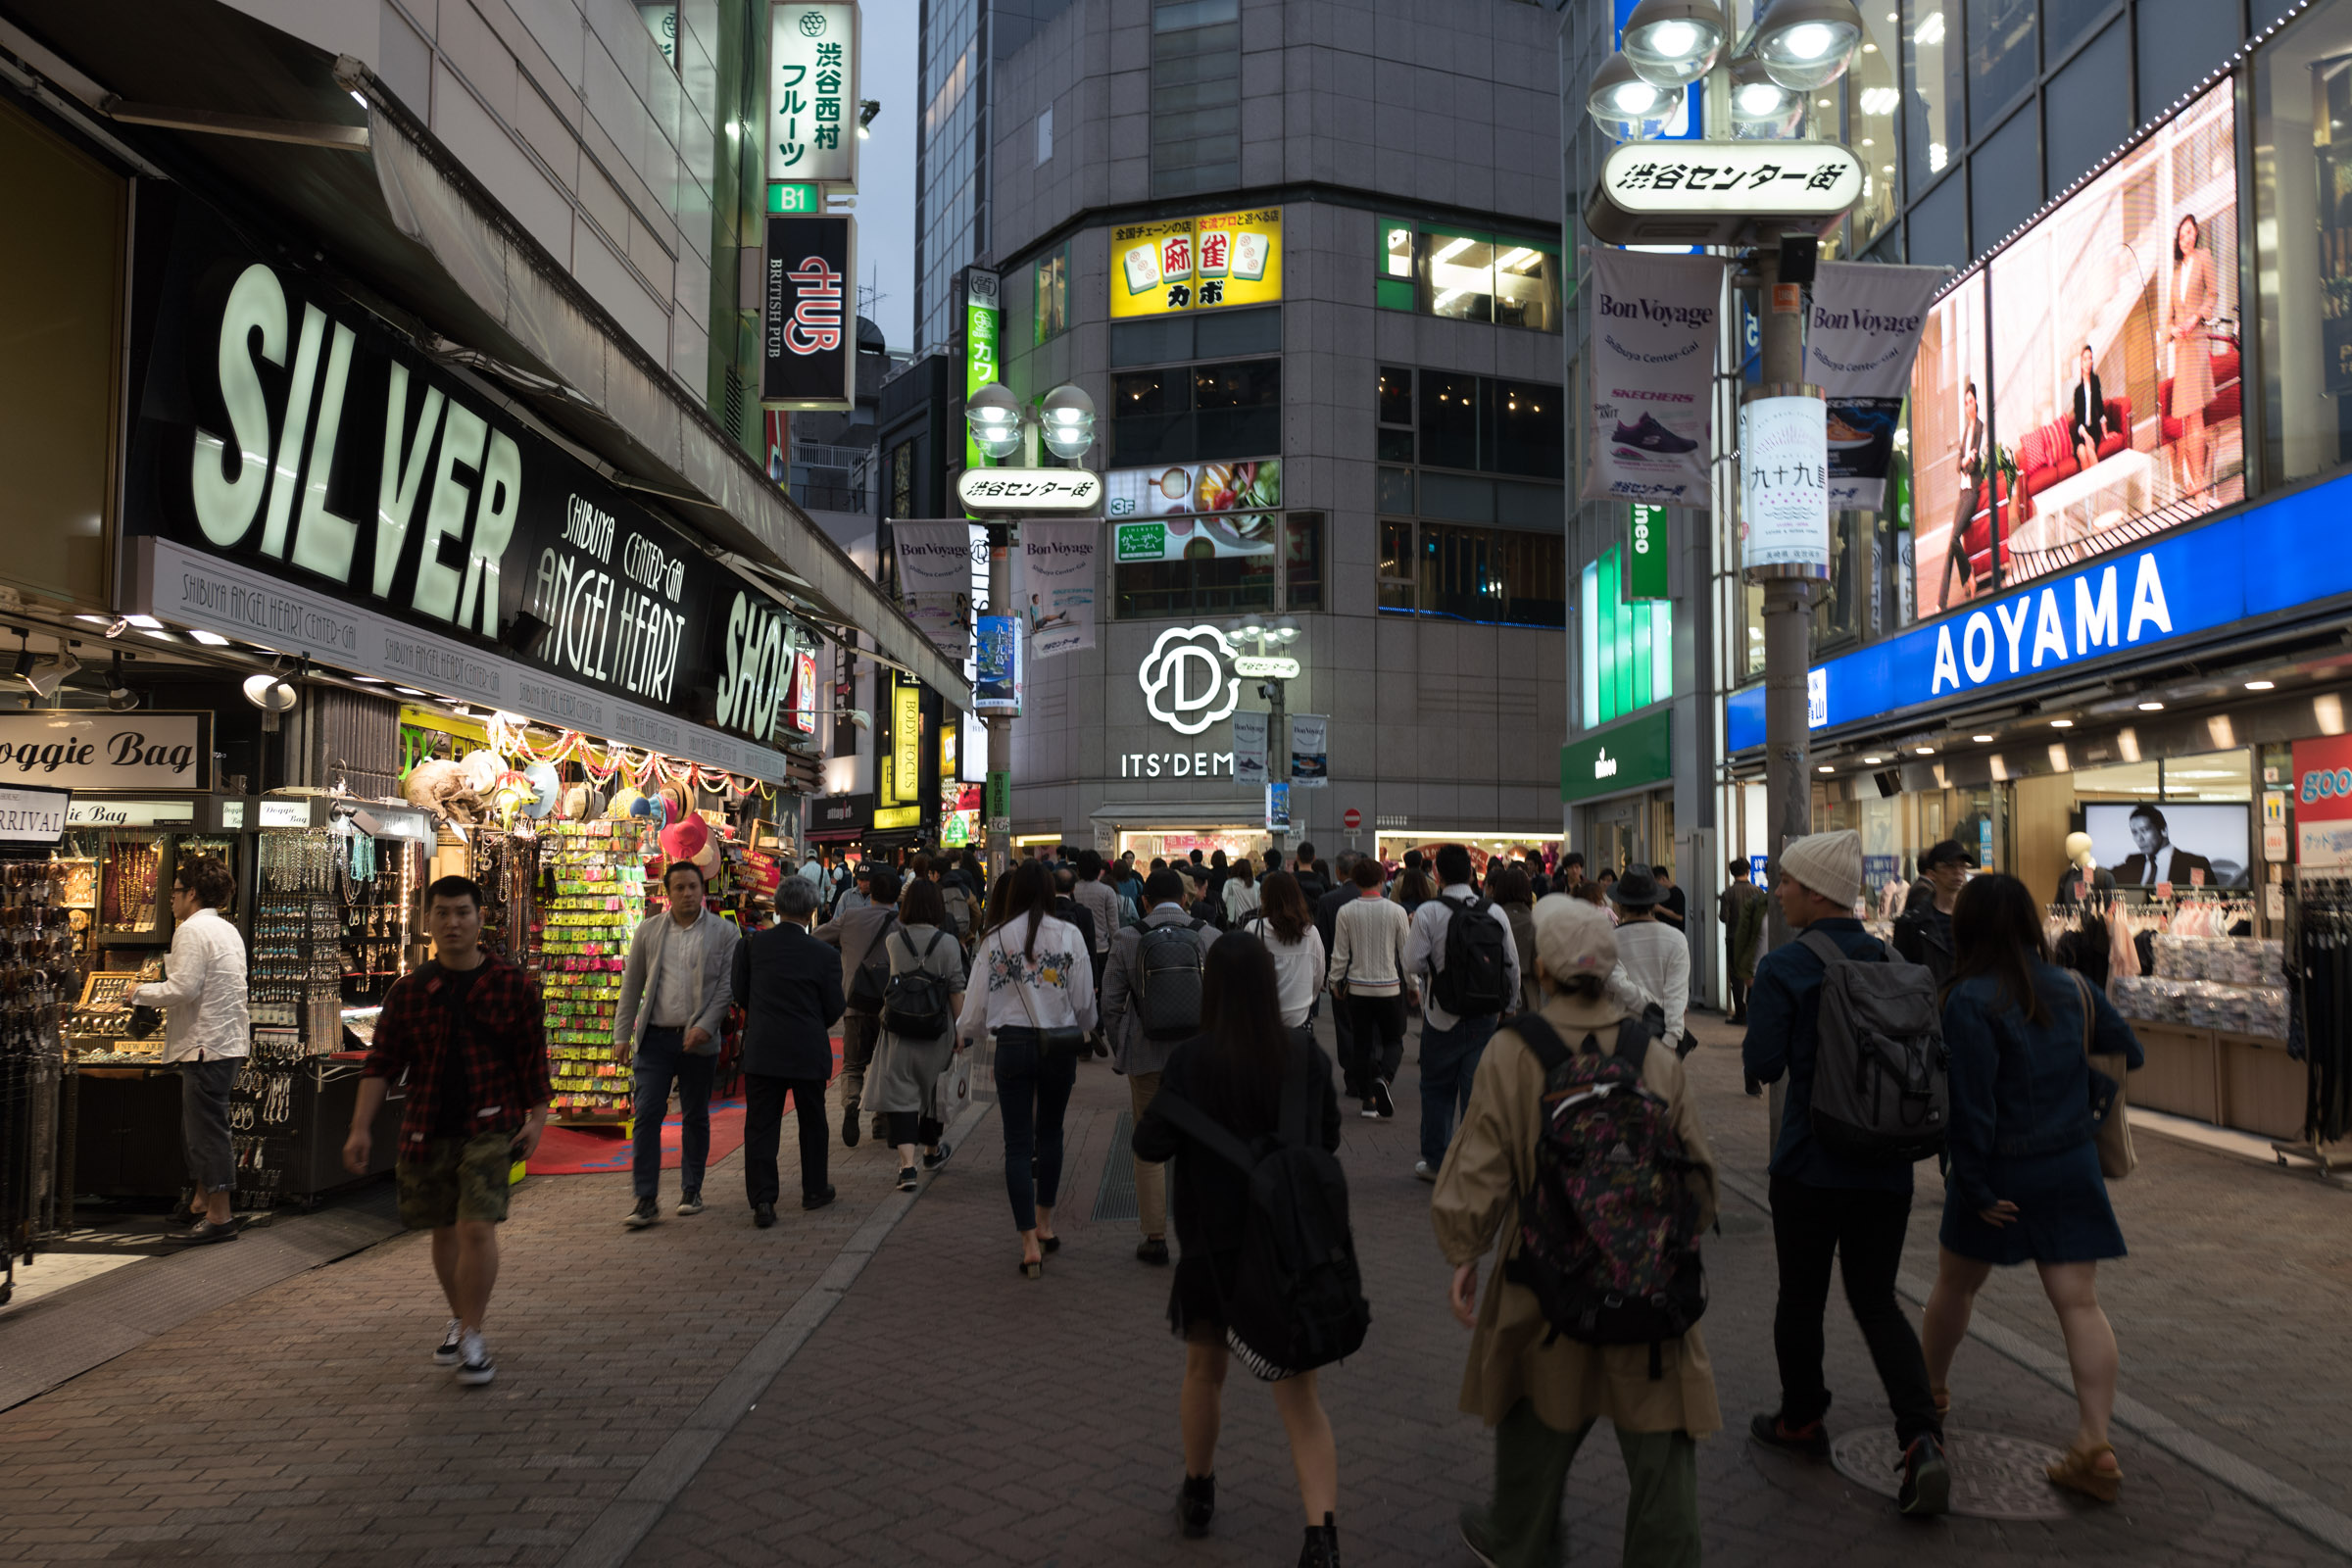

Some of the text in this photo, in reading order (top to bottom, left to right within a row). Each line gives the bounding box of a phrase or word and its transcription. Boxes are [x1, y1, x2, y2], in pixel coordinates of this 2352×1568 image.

[813, 42, 843, 150] 渋谷西村
[779, 65, 808, 167] フルーツ
[1617, 164, 1848, 191] 渋谷センター街
[780, 187, 806, 211] B1
[1115, 220, 1192, 241] 全国チェーンの店
[767, 258, 783, 359] BRITISH PUB
[784, 255, 843, 357] HUB
[1598, 292, 1639, 319] Bon
[1638, 297, 1714, 330] Voyage
[1813, 306, 1920, 338] Bon Voyage
[1604, 333, 1642, 362] Shibuya
[1610, 388, 1696, 404] SKECHERS
[192, 263, 522, 642] SILVER
[966, 481, 1096, 498] 渋谷センター街
[1110, 497, 1136, 515] 3F
[561, 493, 686, 605] SHIBUYA CENTER-GAI
[900, 543, 968, 559] Bon Voyage
[1026, 541, 1094, 557] Bon Voyage
[181, 573, 357, 652] SHIBUYA ANGEL HEART CENTER-GAI
[532, 547, 615, 682] ANGEL
[612, 586, 686, 706] HEART
[1931, 552, 2173, 696] AOYAMA
[995, 623, 1005, 666] 九十九島
[384, 637, 500, 693] SHIBUYA ANGEL HEART CENTER-GAI
[716, 590, 797, 742] SHOP
[107, 732, 196, 774] Bag
[905, 700, 916, 790] BODY FOCUS
[1121, 753, 1235, 777] ITS'DEM
[87, 806, 128, 825] Bag
[264, 806, 295, 814] Doggie
[289, 815, 308, 824] Bag
